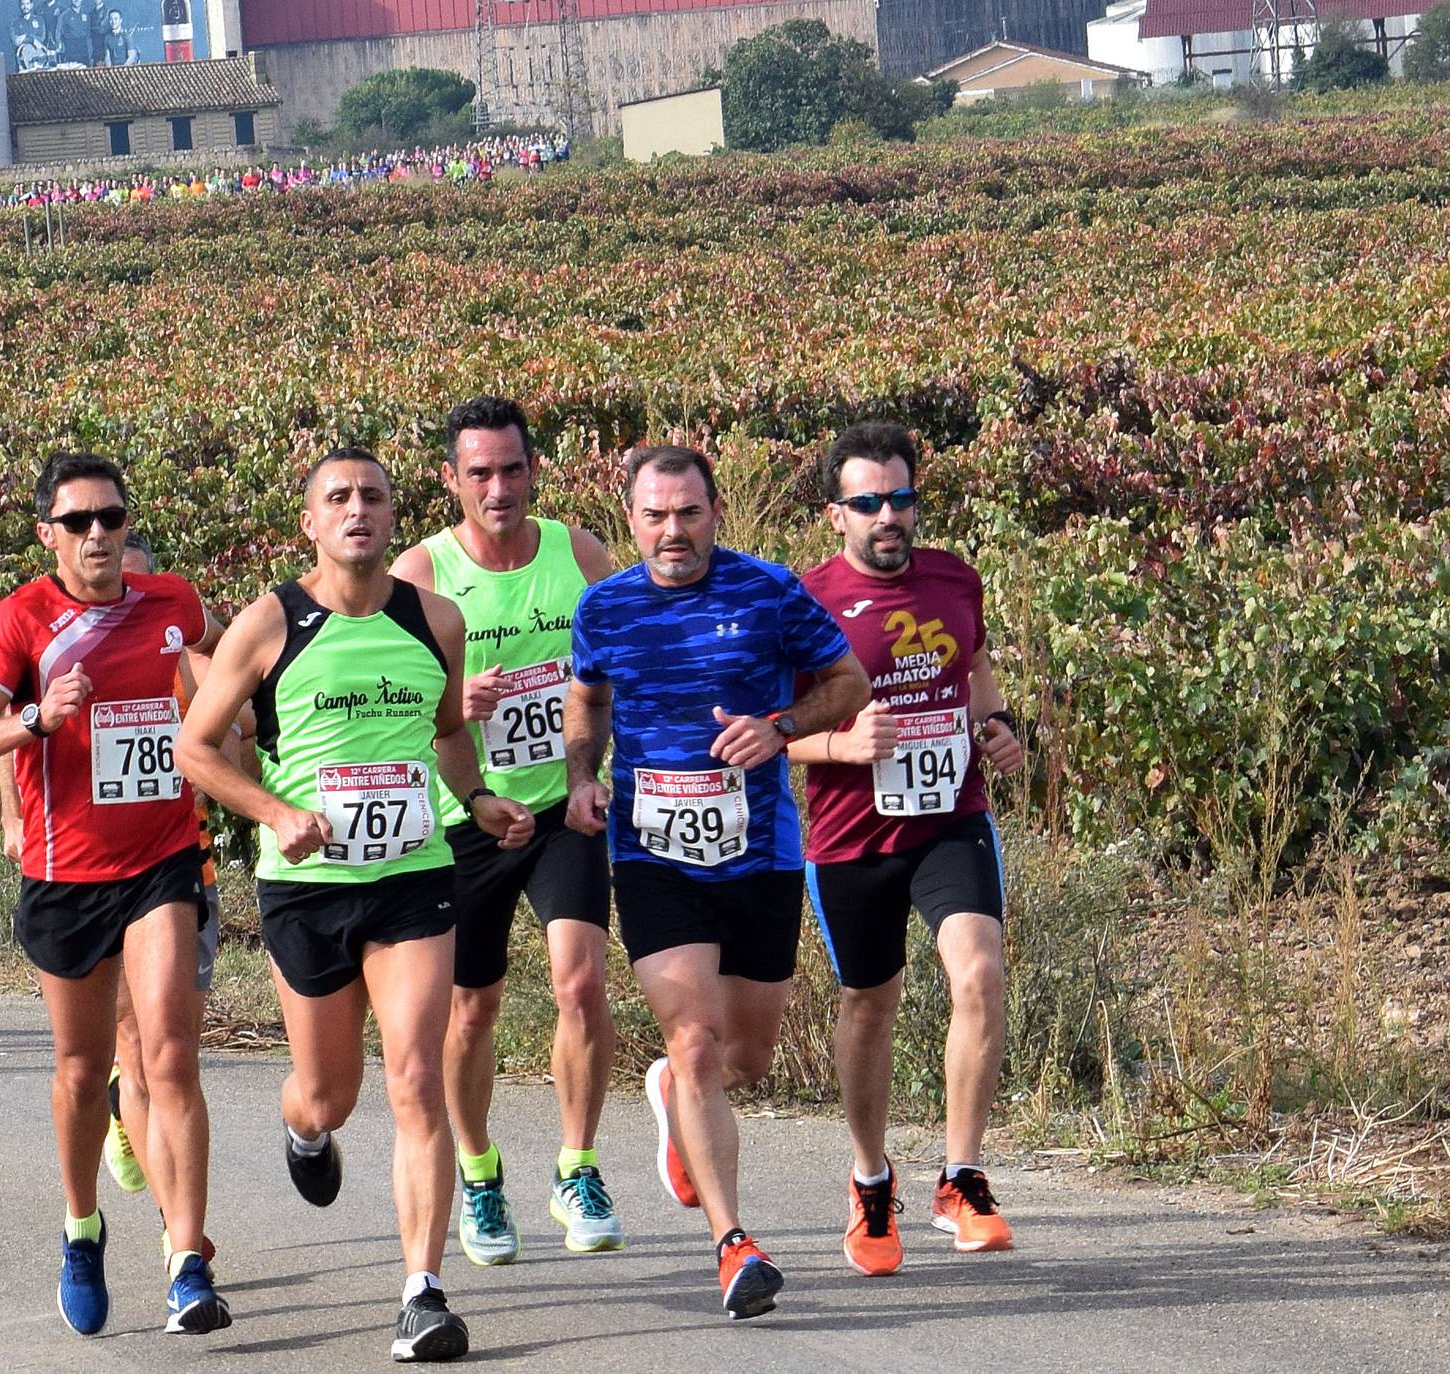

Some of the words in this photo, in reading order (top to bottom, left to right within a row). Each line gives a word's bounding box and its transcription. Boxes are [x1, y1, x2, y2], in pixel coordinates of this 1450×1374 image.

[465, 625, 521, 649] ampo
[884, 610, 957, 668] 25
[895, 651, 942, 669] MEDIA
[515, 666, 546, 680] CARRERA
[524, 671, 559, 689] VIÑEDOS
[872, 665, 942, 689] MARATÓN
[314, 691, 368, 720] Campo
[375, 680, 423, 705] Activo
[521, 692, 541, 702] MAXI
[132, 702, 164, 712] CARRERA
[356, 710, 382, 719] Fuchu
[386, 709, 422, 718] Runners
[115, 711, 139, 724] ENTRE
[140, 708, 172, 723] VIÑEDOS
[503, 697, 563, 744] 266
[915, 715, 947, 725] CARRERA
[922, 722, 953, 735] VIÑEDOS
[898, 740, 928, 750] MIGUEL
[115, 735, 175, 776] 786
[362, 766, 397, 775] CARRERA
[897, 747, 956, 789] 194
[342, 776, 370, 787] ENTRE
[371, 773, 406, 786] VIÑEDOS
[675, 775, 710, 783] CARRERA
[361, 791, 391, 800] JAVIER
[657, 784, 684, 793] ENTRE
[684, 782, 721, 794] VIÑEDOS
[674, 799, 703, 807] JAVIER
[343, 800, 408, 840] 767
[417, 793, 429, 836] CENICERO
[657, 807, 724, 844] 739
